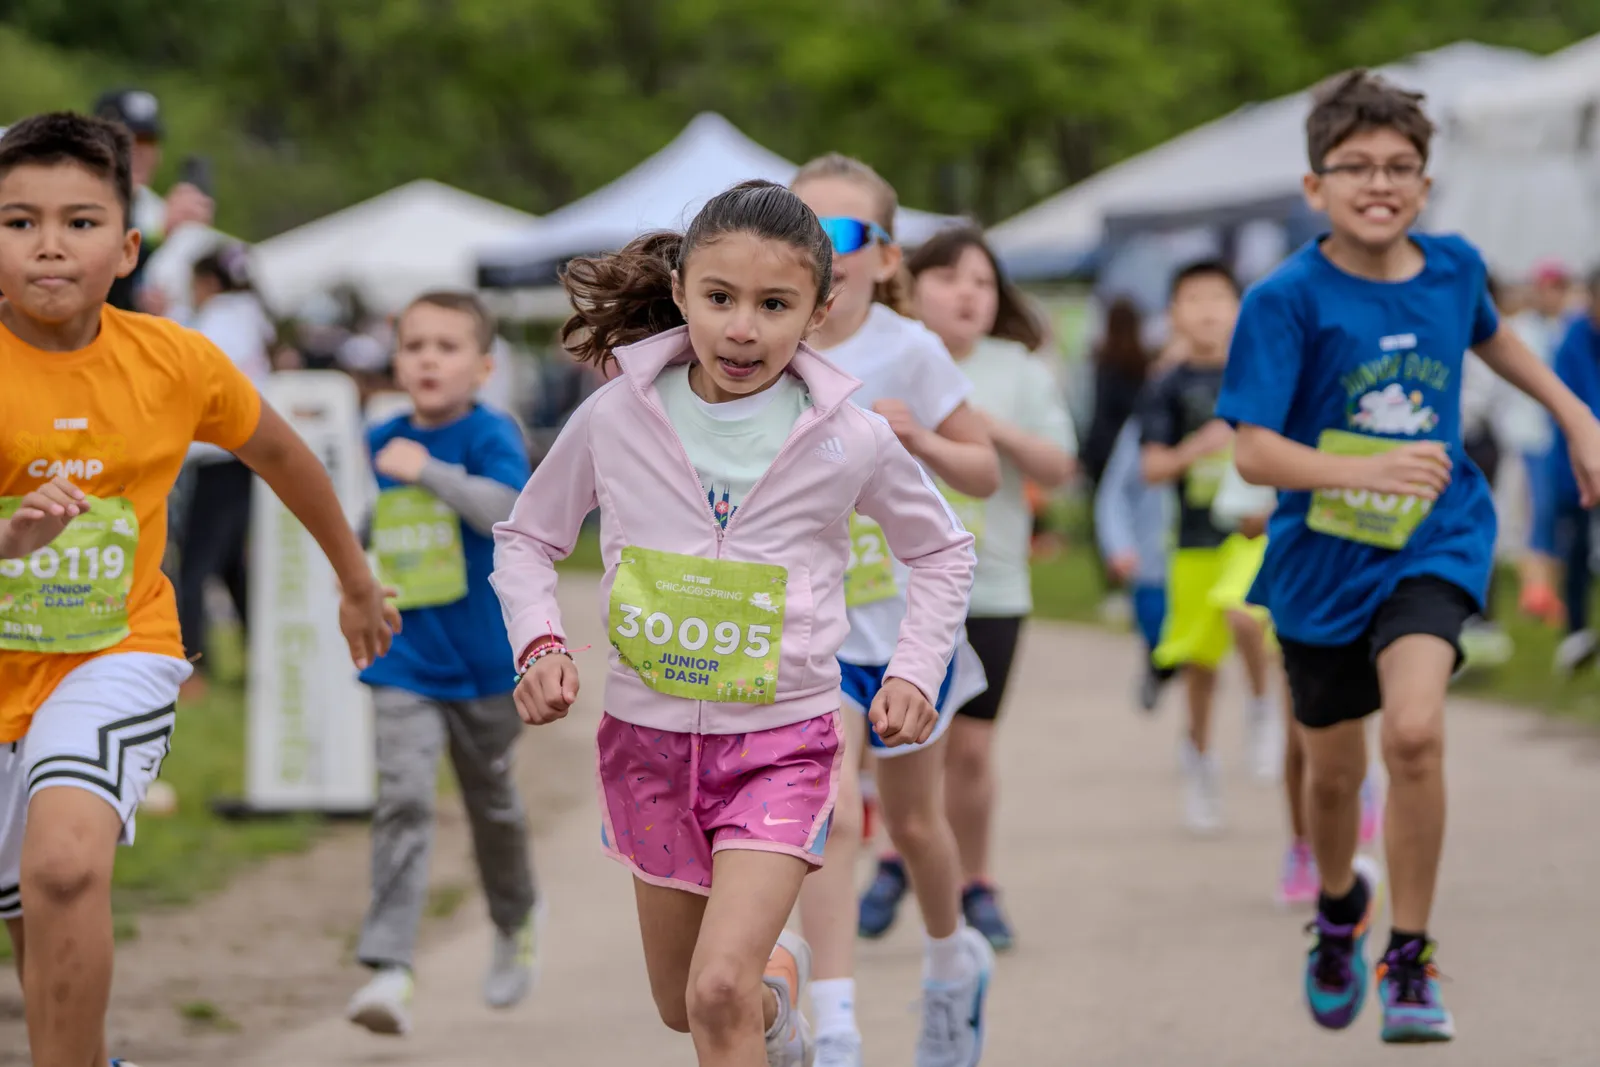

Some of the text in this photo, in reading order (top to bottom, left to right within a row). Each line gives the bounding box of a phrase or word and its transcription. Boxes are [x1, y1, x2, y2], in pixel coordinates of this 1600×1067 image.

[28, 459, 104, 480] CAMP
[39, 584, 92, 595] JUNIOR
[656, 580, 743, 601] CHICAGO SPRING
[45, 597, 84, 607] DASH
[616, 603, 772, 658] 30095
[658, 653, 720, 672] JUNIOR
[664, 668, 709, 686] DASH
